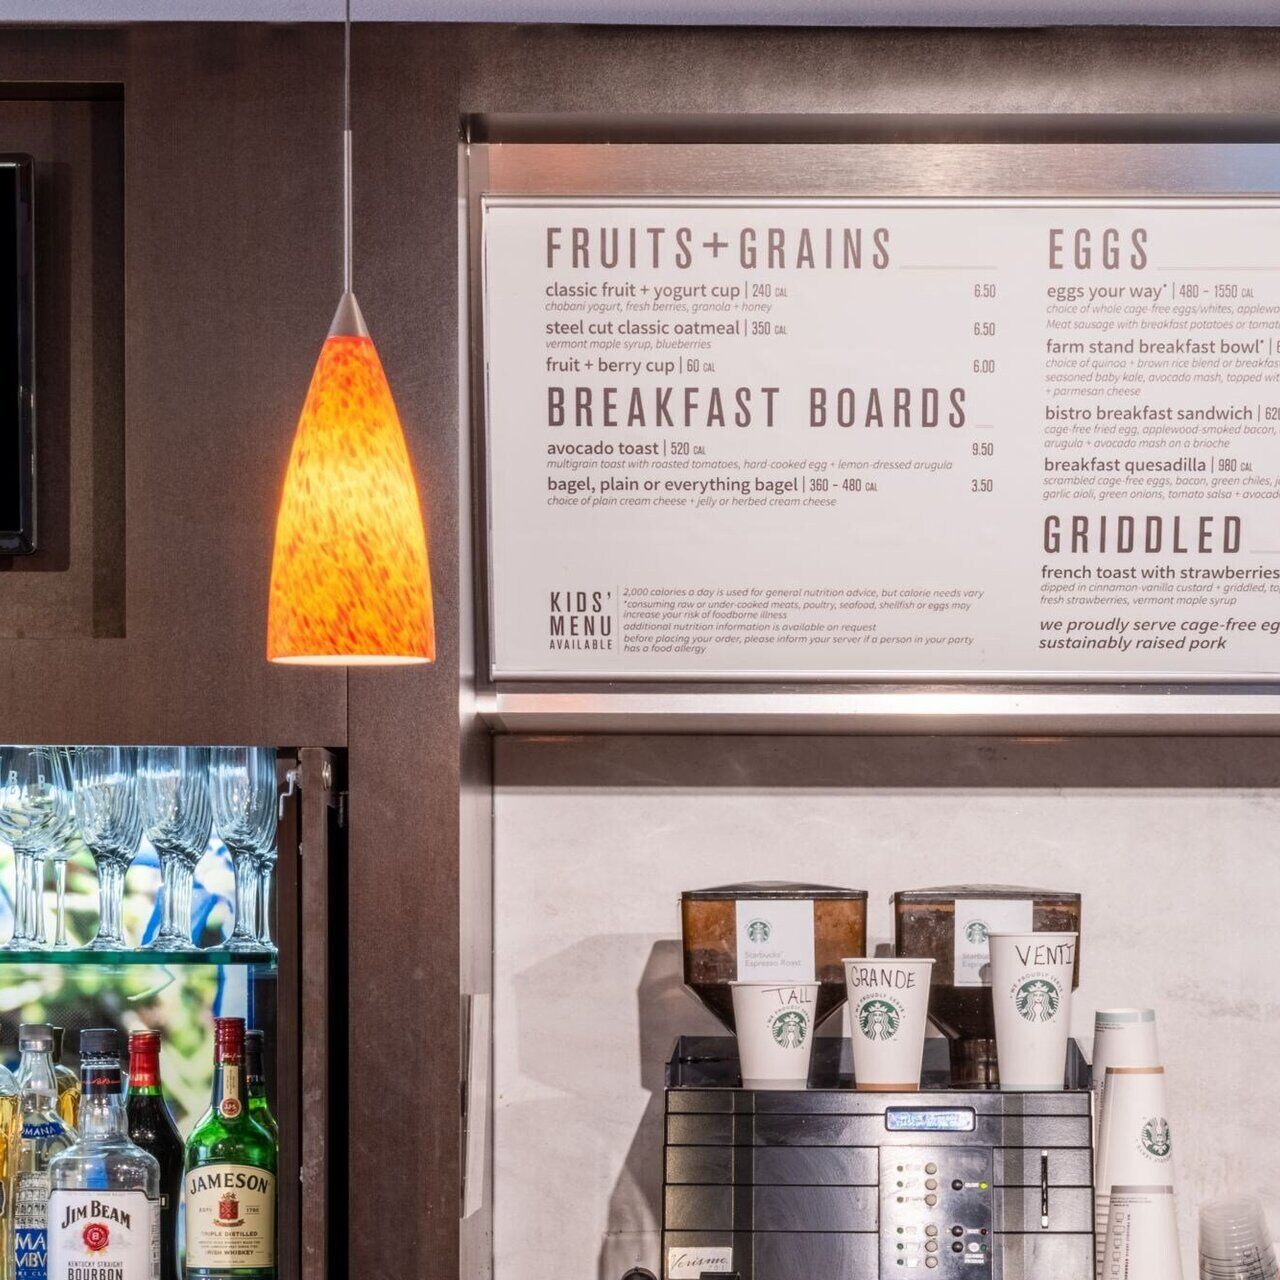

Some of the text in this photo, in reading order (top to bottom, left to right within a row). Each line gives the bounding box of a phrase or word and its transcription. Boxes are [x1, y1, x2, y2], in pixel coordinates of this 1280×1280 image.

[1048, 227, 1148, 271] EGGS
[545, 281, 598, 298] classic
[601, 281, 636, 298] fruit
[653, 283, 707, 302] yogurt
[710, 286, 741, 303] cup
[752, 283, 772, 298] 240
[775, 287, 787, 297] CAL
[974, 283, 997, 299] 6.50
[545, 301, 584, 313] chobani
[586, 303, 623, 314] yogurt,
[625, 301, 650, 313] fresh
[651, 301, 689, 314] berries,
[691, 301, 731, 315] granola
[741, 301, 772, 315] honey
[547, 386, 966, 429] BREAKFAST BOARDS
[1045, 405, 1092, 421] bistro
[1096, 405, 1173, 421] breakfast
[1176, 405, 1253, 421] sandwich
[1043, 514, 1241, 554] GRIDDLED
[1041, 564, 1092, 579] french
[1095, 566, 1137, 579] toast
[1140, 565, 1176, 579] with
[1180, 565, 1280, 580] strawberries
[550, 591, 611, 613] KIDS'
[549, 615, 611, 637] MENU
[549, 638, 613, 650] AVAILABLE
[1015, 943, 1074, 966] VENTI
[851, 965, 916, 989] GRANDE
[761, 986, 813, 1005] TALL
[190, 1172, 269, 1196] JAMESON
[61, 1200, 132, 1230] JIM BEAM
